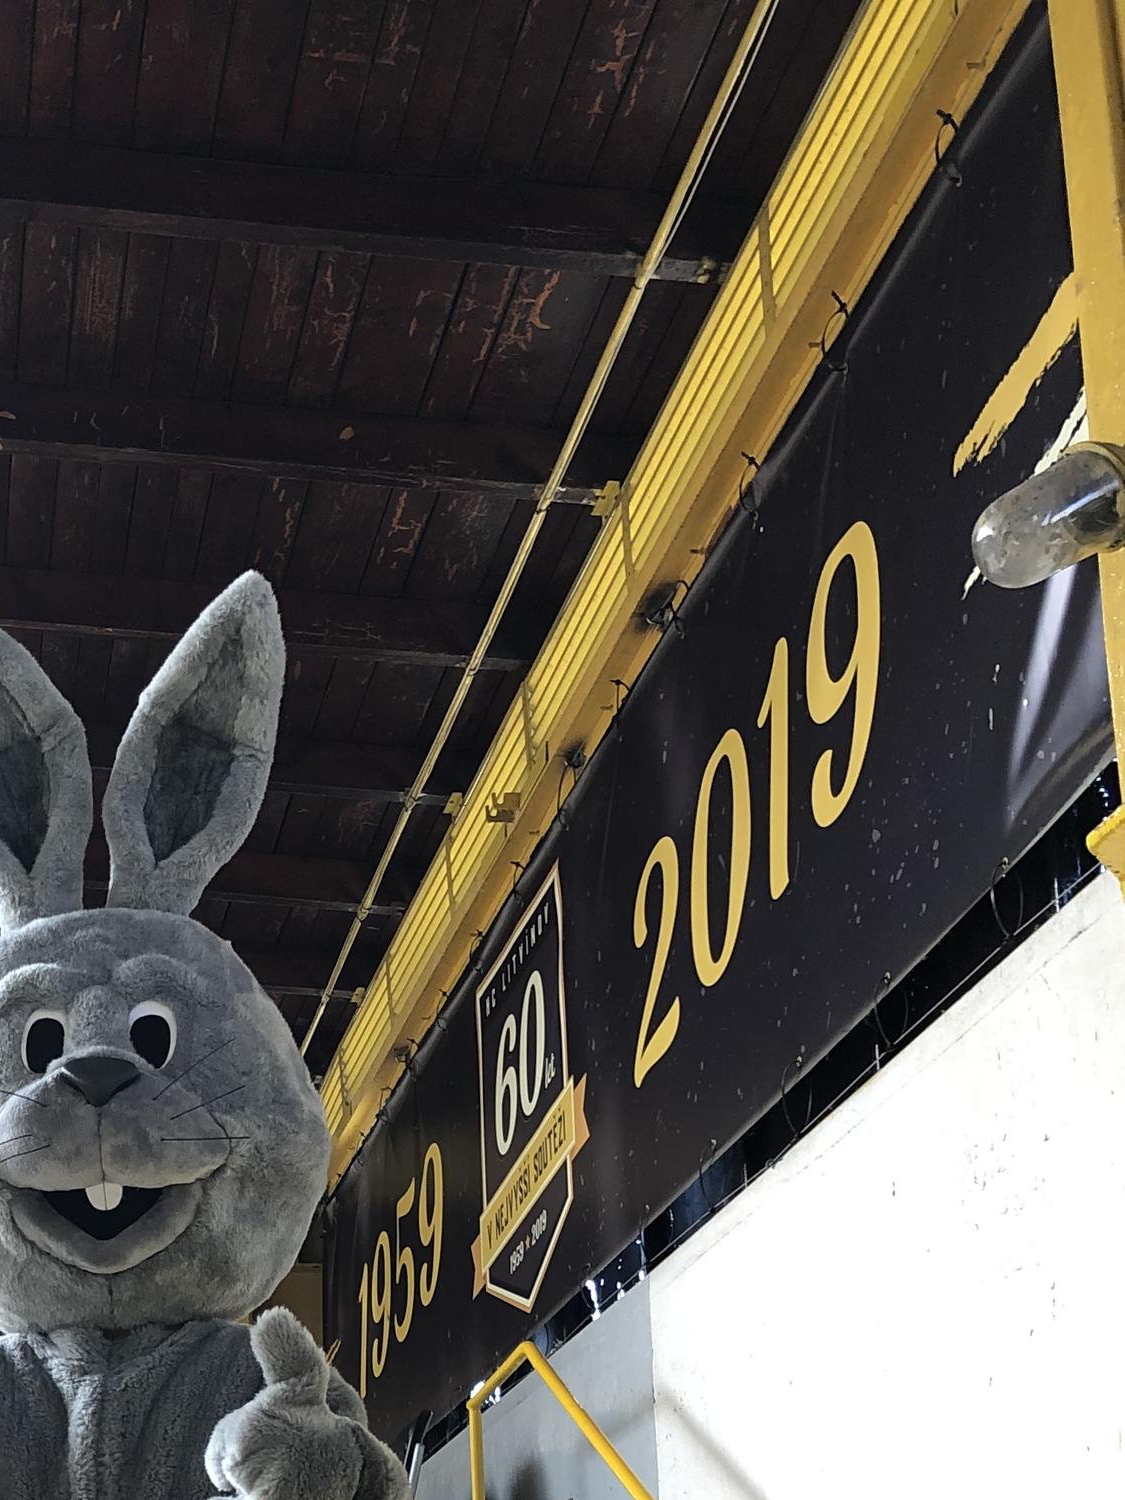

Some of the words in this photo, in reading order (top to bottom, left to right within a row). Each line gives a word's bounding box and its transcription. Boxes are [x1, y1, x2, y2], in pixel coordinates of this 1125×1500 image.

[634, 521, 881, 1089] 2019
[495, 970, 545, 1156] 60
[359, 1142, 443, 1400] 1959
[509, 1240, 525, 1275] 1959
[530, 1209, 548, 1246] 2019
